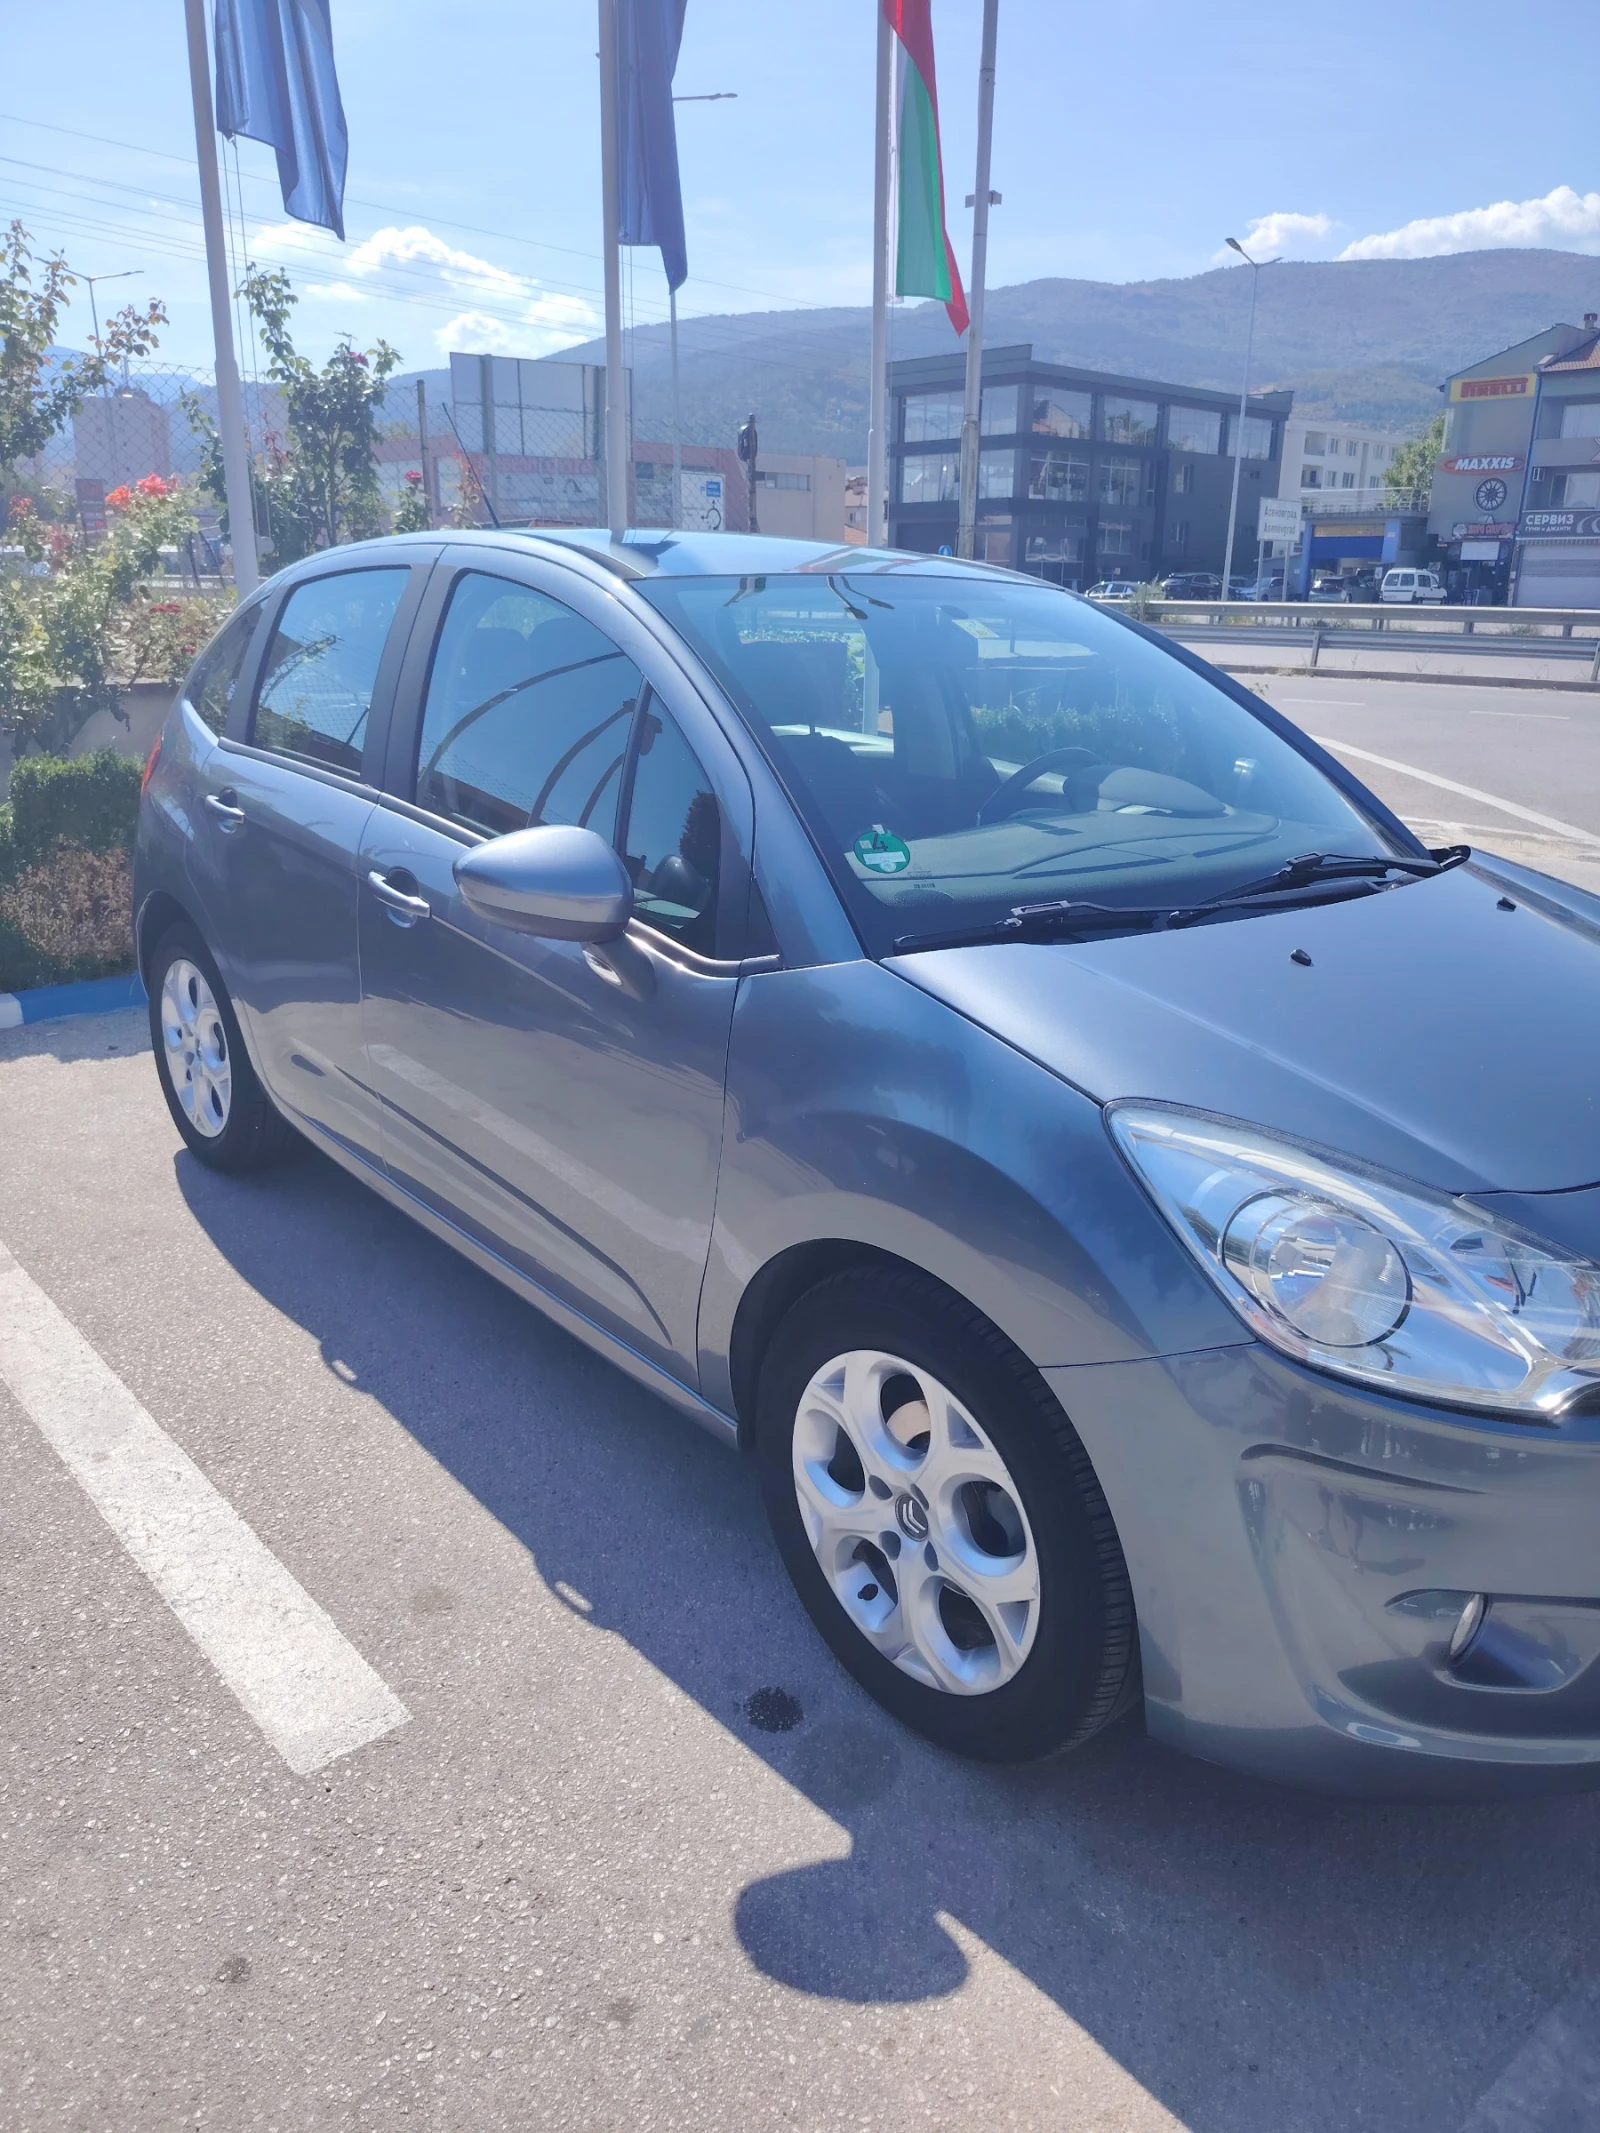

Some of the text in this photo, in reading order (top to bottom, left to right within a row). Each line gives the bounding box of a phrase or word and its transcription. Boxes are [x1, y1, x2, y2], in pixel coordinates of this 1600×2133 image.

[1460, 377, 1528, 398] PIRELLI
[1454, 457, 1515, 471] MAXXIS
[1264, 505, 1297, 520] Асеновград
[1525, 514, 1575, 525] СЕРВИЗ
[1264, 522, 1296, 537] Asenovgrad
[872, 832, 888, 852] 4
